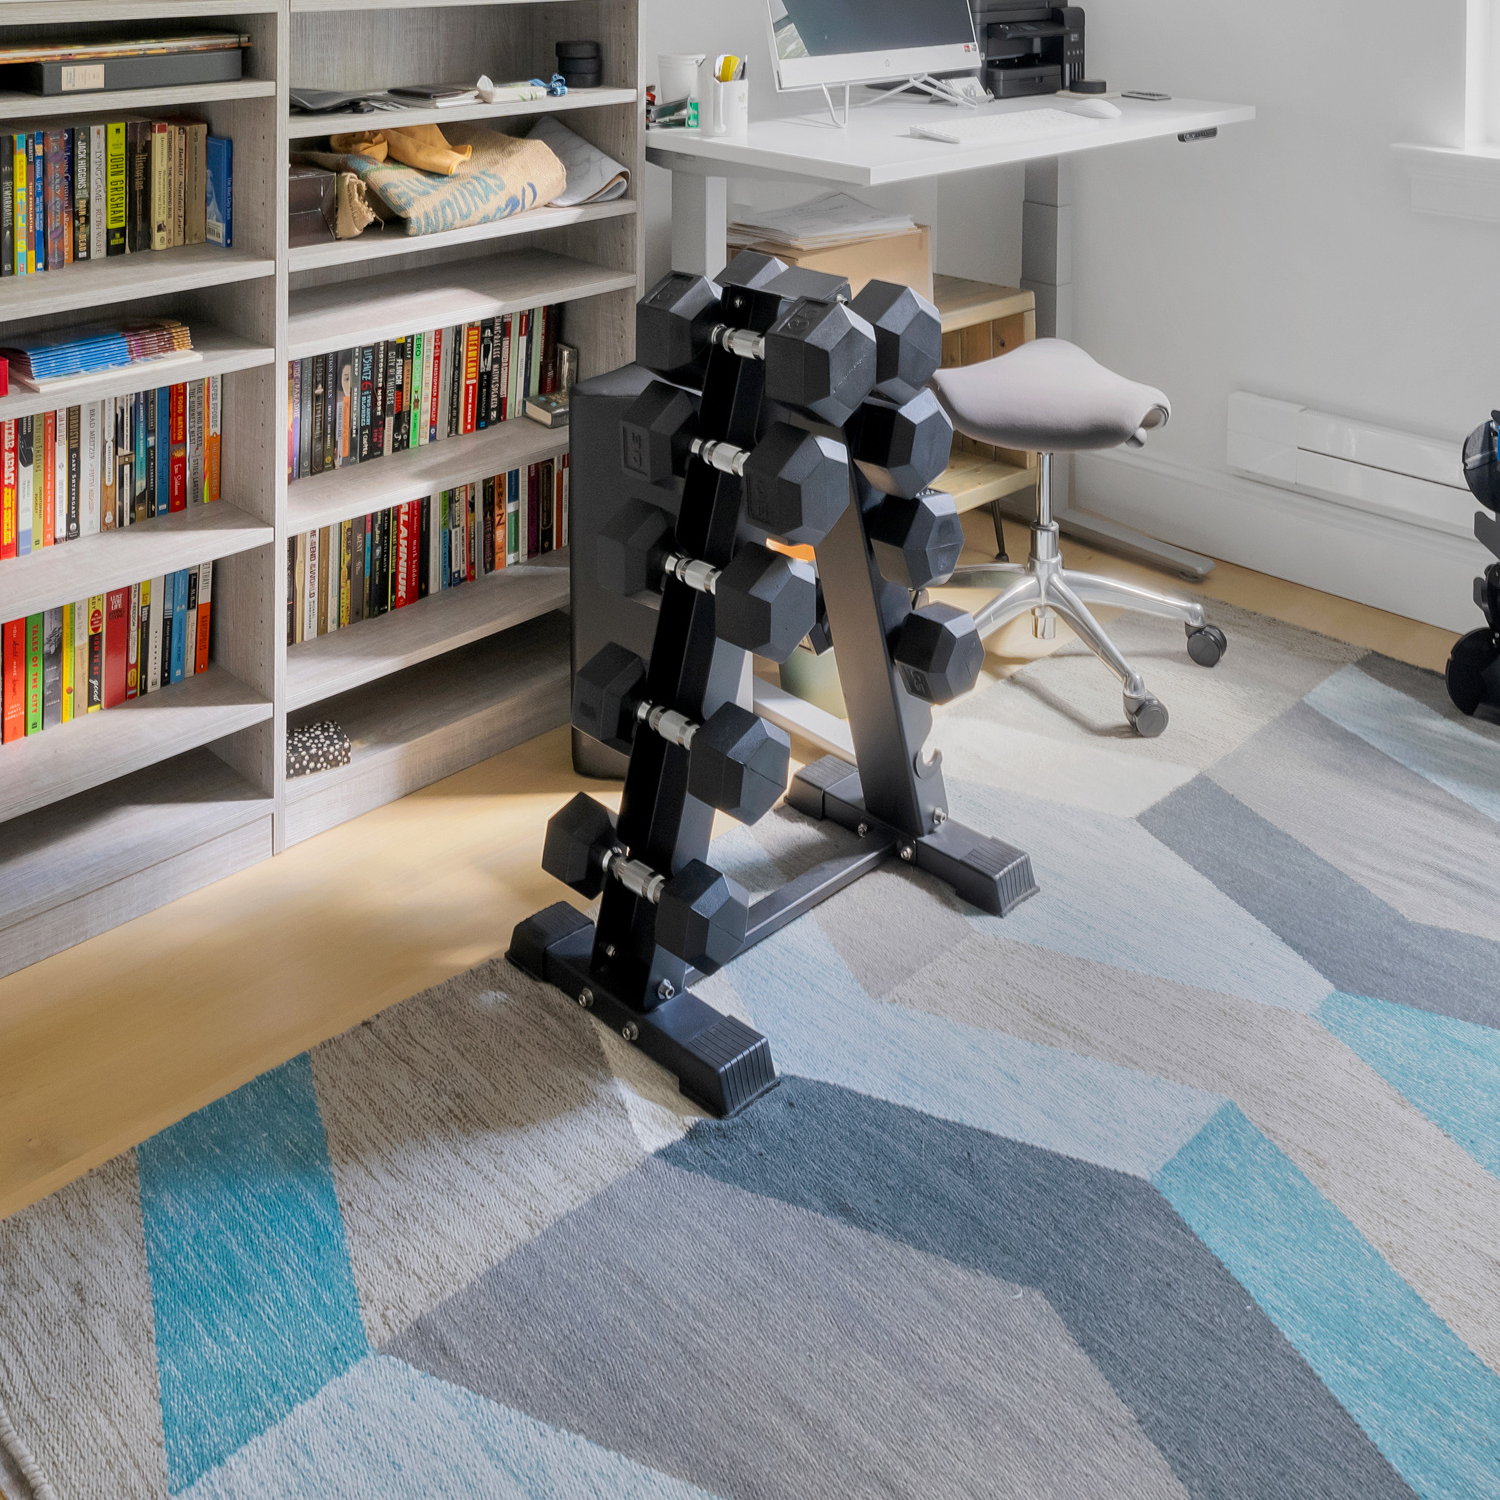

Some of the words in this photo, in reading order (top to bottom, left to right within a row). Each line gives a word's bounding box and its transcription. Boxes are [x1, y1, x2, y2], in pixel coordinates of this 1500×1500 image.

[110, 153, 125, 180] JOHN
[110, 181, 126, 225] GRISHAM
[467, 329, 479, 379] DREAMLAND
[32, 656, 38, 670] OF
